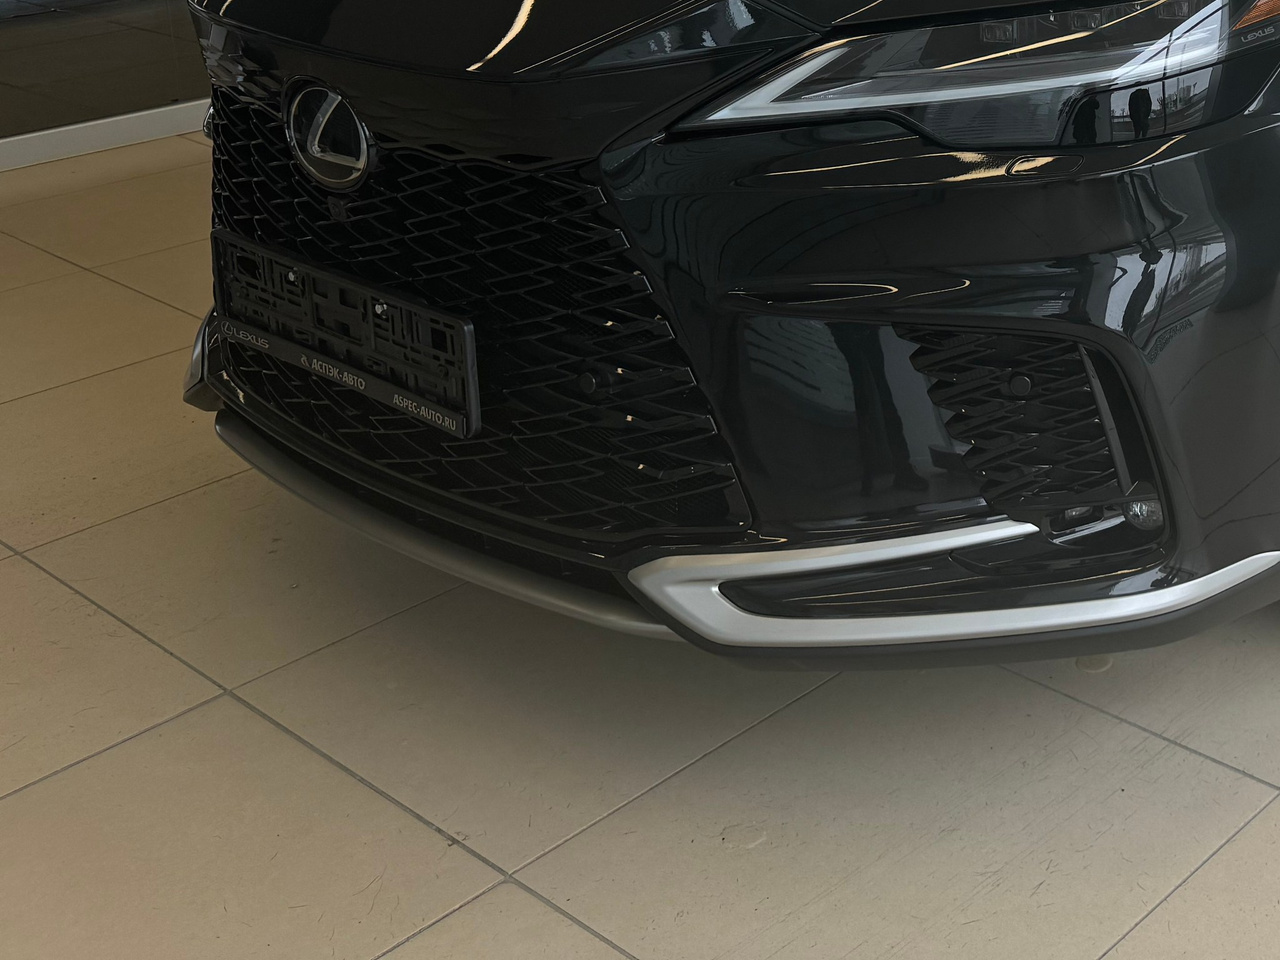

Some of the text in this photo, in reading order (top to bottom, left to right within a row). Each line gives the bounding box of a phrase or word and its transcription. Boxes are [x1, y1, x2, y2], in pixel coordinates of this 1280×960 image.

[1241, 26, 1275, 43] LEXUS
[234, 327, 270, 349] LEXUS
[311, 358, 366, 391] АСПЭК-АВТО
[392, 394, 456, 431] ASPEC-AUTO.RU
